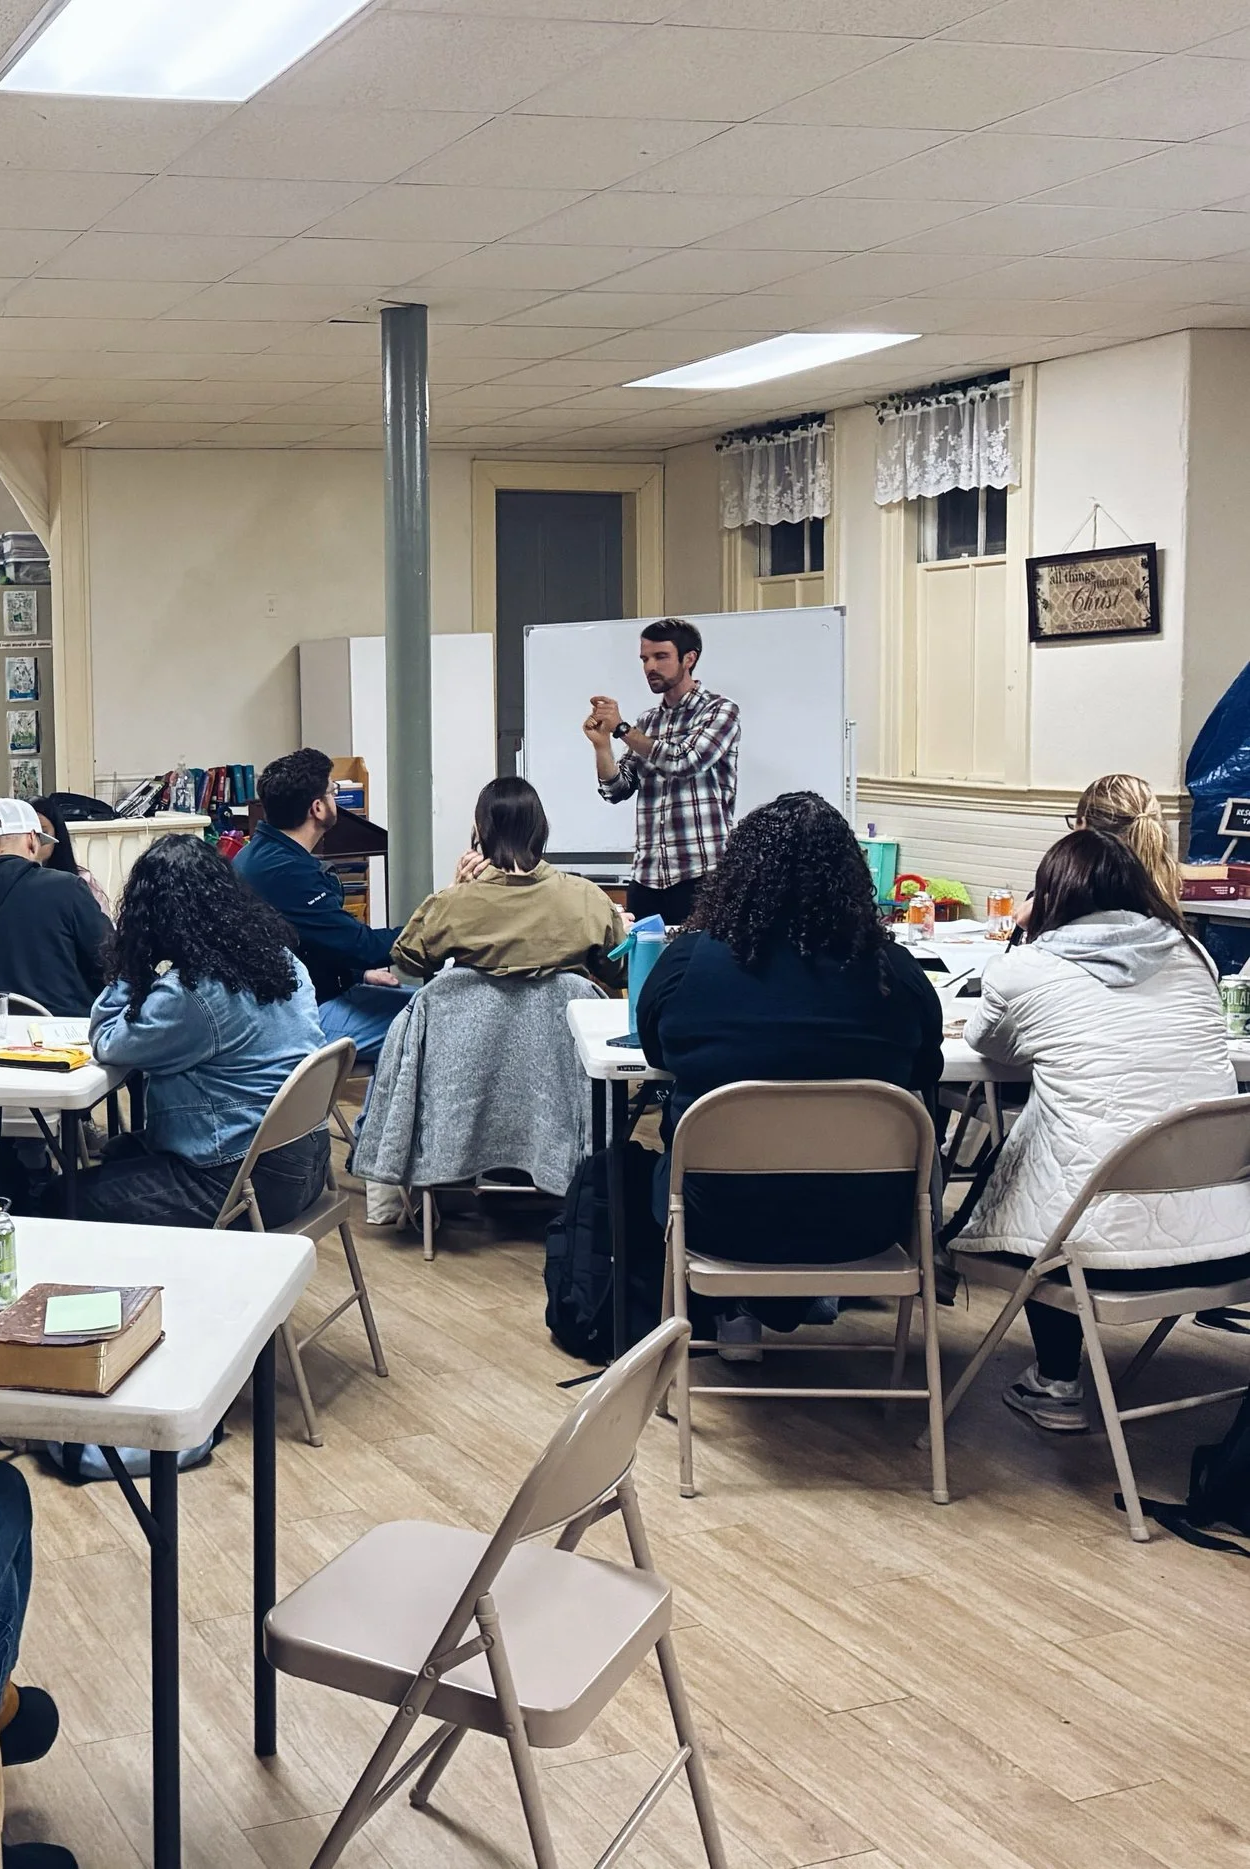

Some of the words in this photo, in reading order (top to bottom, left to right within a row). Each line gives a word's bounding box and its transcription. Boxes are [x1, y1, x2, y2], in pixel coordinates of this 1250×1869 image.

[1050, 571, 1062, 584] all
[1064, 570, 1096, 585] things
[1070, 585, 1123, 613] Christ
[1236, 808, 1250, 817] RES
